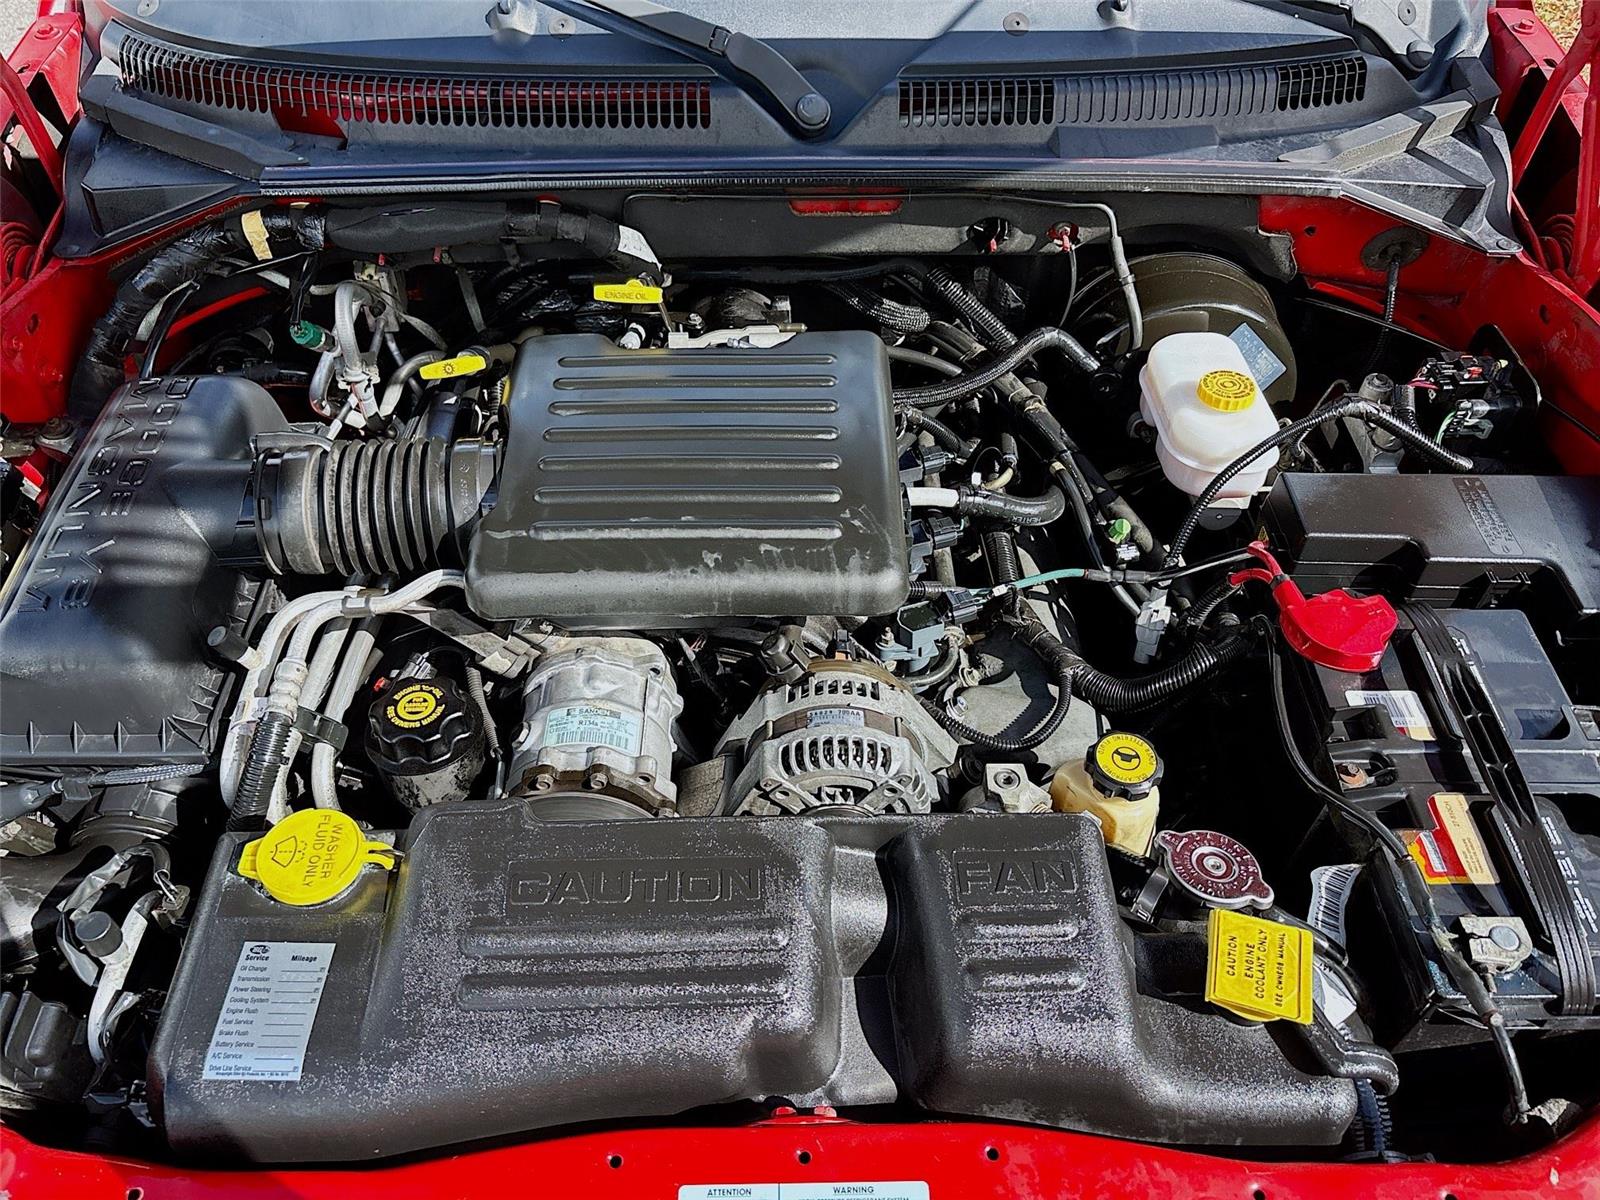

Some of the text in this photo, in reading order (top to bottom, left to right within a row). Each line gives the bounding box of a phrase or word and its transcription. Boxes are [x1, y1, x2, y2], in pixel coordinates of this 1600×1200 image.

[604, 291, 649, 301] ENGINE OIL
[17, 377, 163, 613] MAGNUM
[59, 376, 199, 609] DODGE V8
[393, 684, 421, 700] ENGINE
[386, 703, 446, 728] SEE OWNERS MANUAL
[303, 814, 331, 887] FLUID ONLY
[320, 823, 343, 880] WASHER
[508, 859, 1076, 905] CAUTION FAN
[1226, 935, 1238, 977] CAUTION
[1244, 943, 1256, 979] ENGINE
[1255, 929, 1268, 999] COOLANT ONLY
[1274, 932, 1286, 1007] SEE OWNERS MANUAL
[215, 1041, 234, 1049] Battery
[707, 1185, 875, 1196] ATTENTION WARNING
